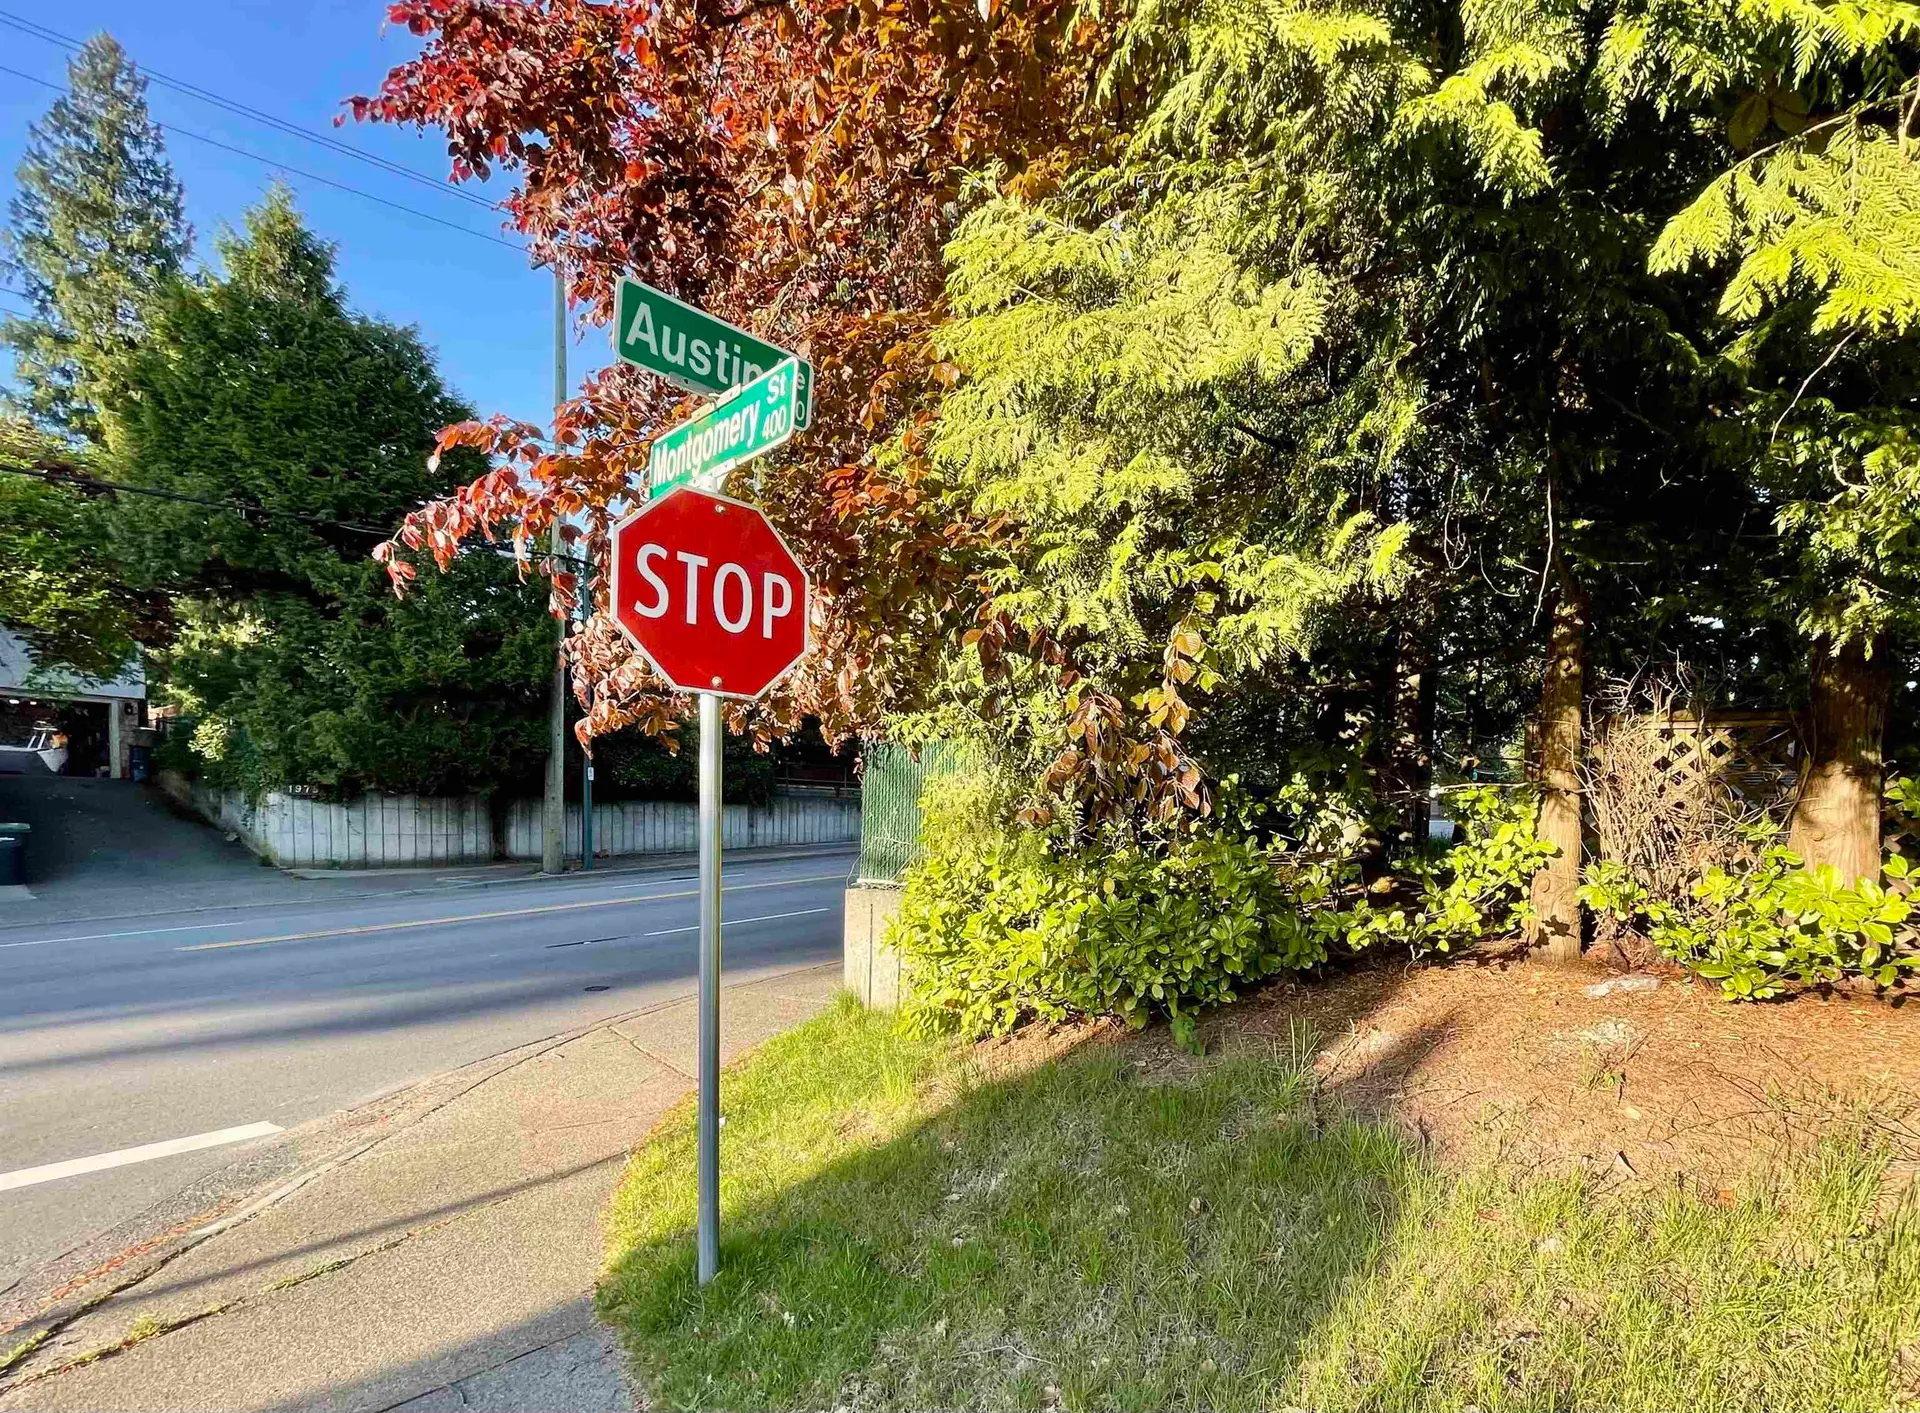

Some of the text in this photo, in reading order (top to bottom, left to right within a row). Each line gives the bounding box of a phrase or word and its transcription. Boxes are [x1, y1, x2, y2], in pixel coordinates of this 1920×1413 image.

[652, 371, 787, 488] Montgomery St
[762, 405, 787, 439] 400
[634, 543, 793, 639] STOP
